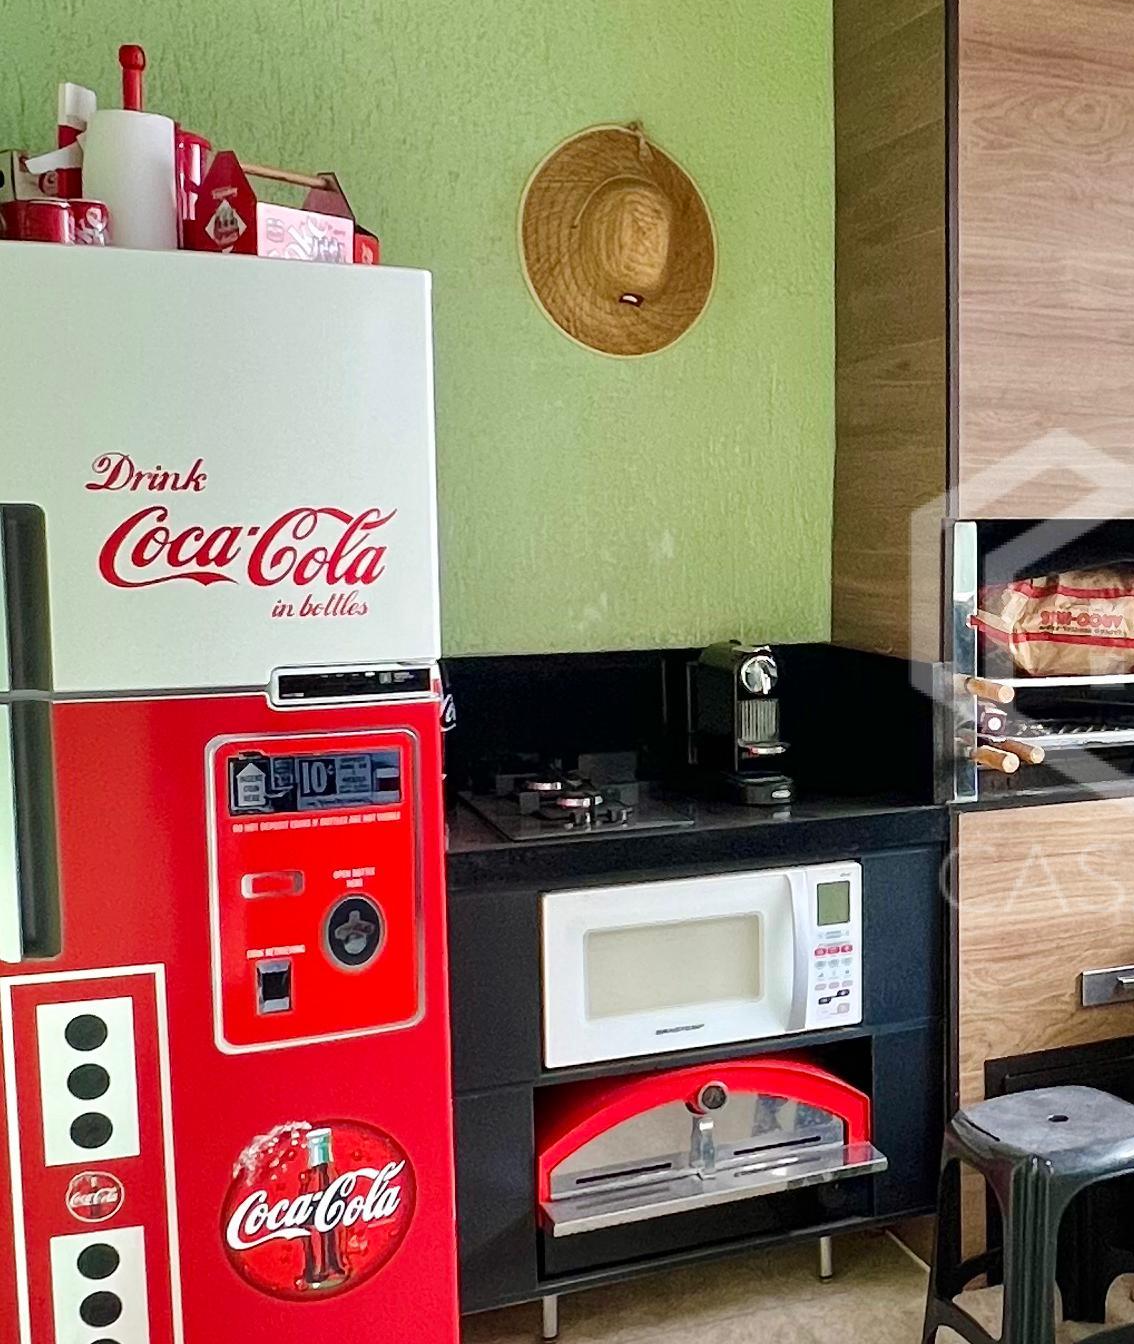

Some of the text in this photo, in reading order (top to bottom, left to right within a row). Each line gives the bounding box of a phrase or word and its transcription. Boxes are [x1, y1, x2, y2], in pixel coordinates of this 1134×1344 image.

[85, 451, 208, 492] Drink
[98, 505, 397, 588] Coca-Cola
[271, 590, 369, 619] in bottles
[226, 1159, 406, 1251] Coca-Cola
